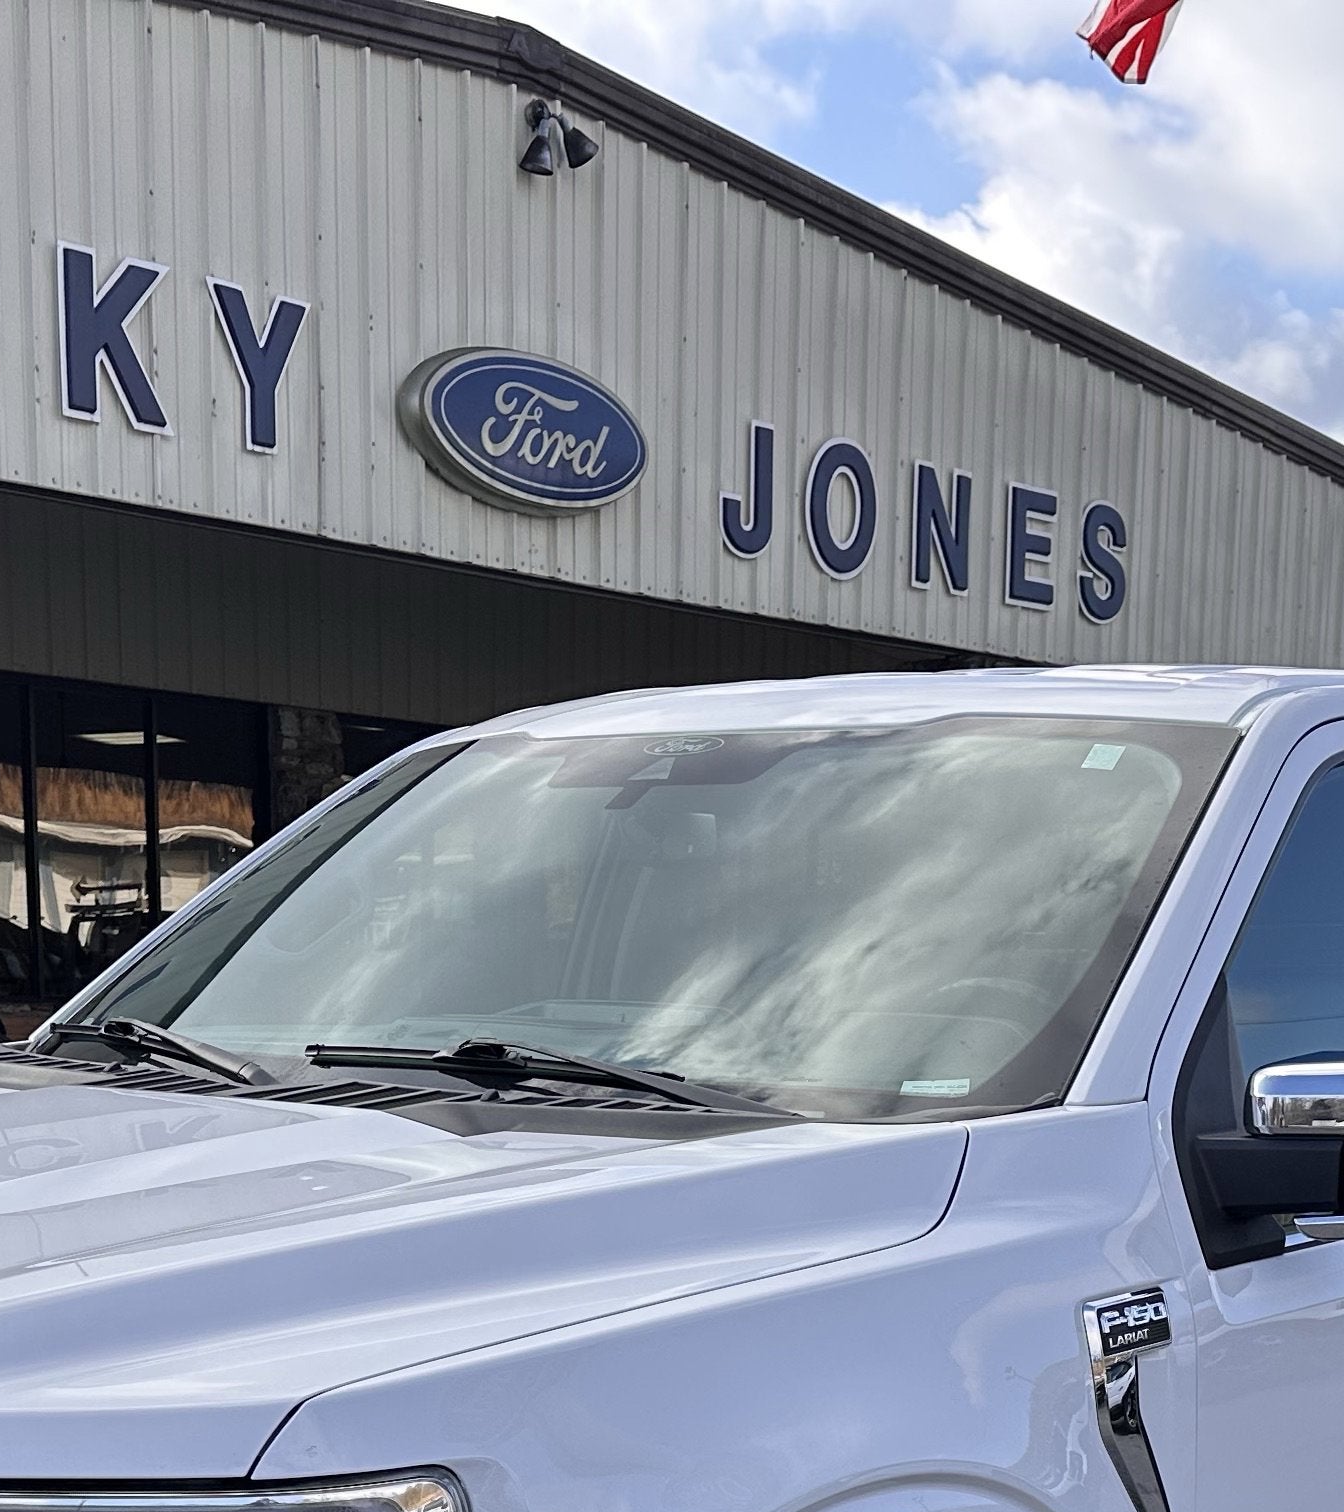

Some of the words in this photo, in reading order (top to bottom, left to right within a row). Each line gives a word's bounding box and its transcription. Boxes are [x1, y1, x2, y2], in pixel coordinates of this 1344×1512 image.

[481, 381, 610, 478] Ford
[719, 419, 1127, 624] JONES
[654, 738, 713, 753] Ford
[1100, 1302, 1168, 1334] F-150
[1109, 1330, 1150, 1348] LARIAT
